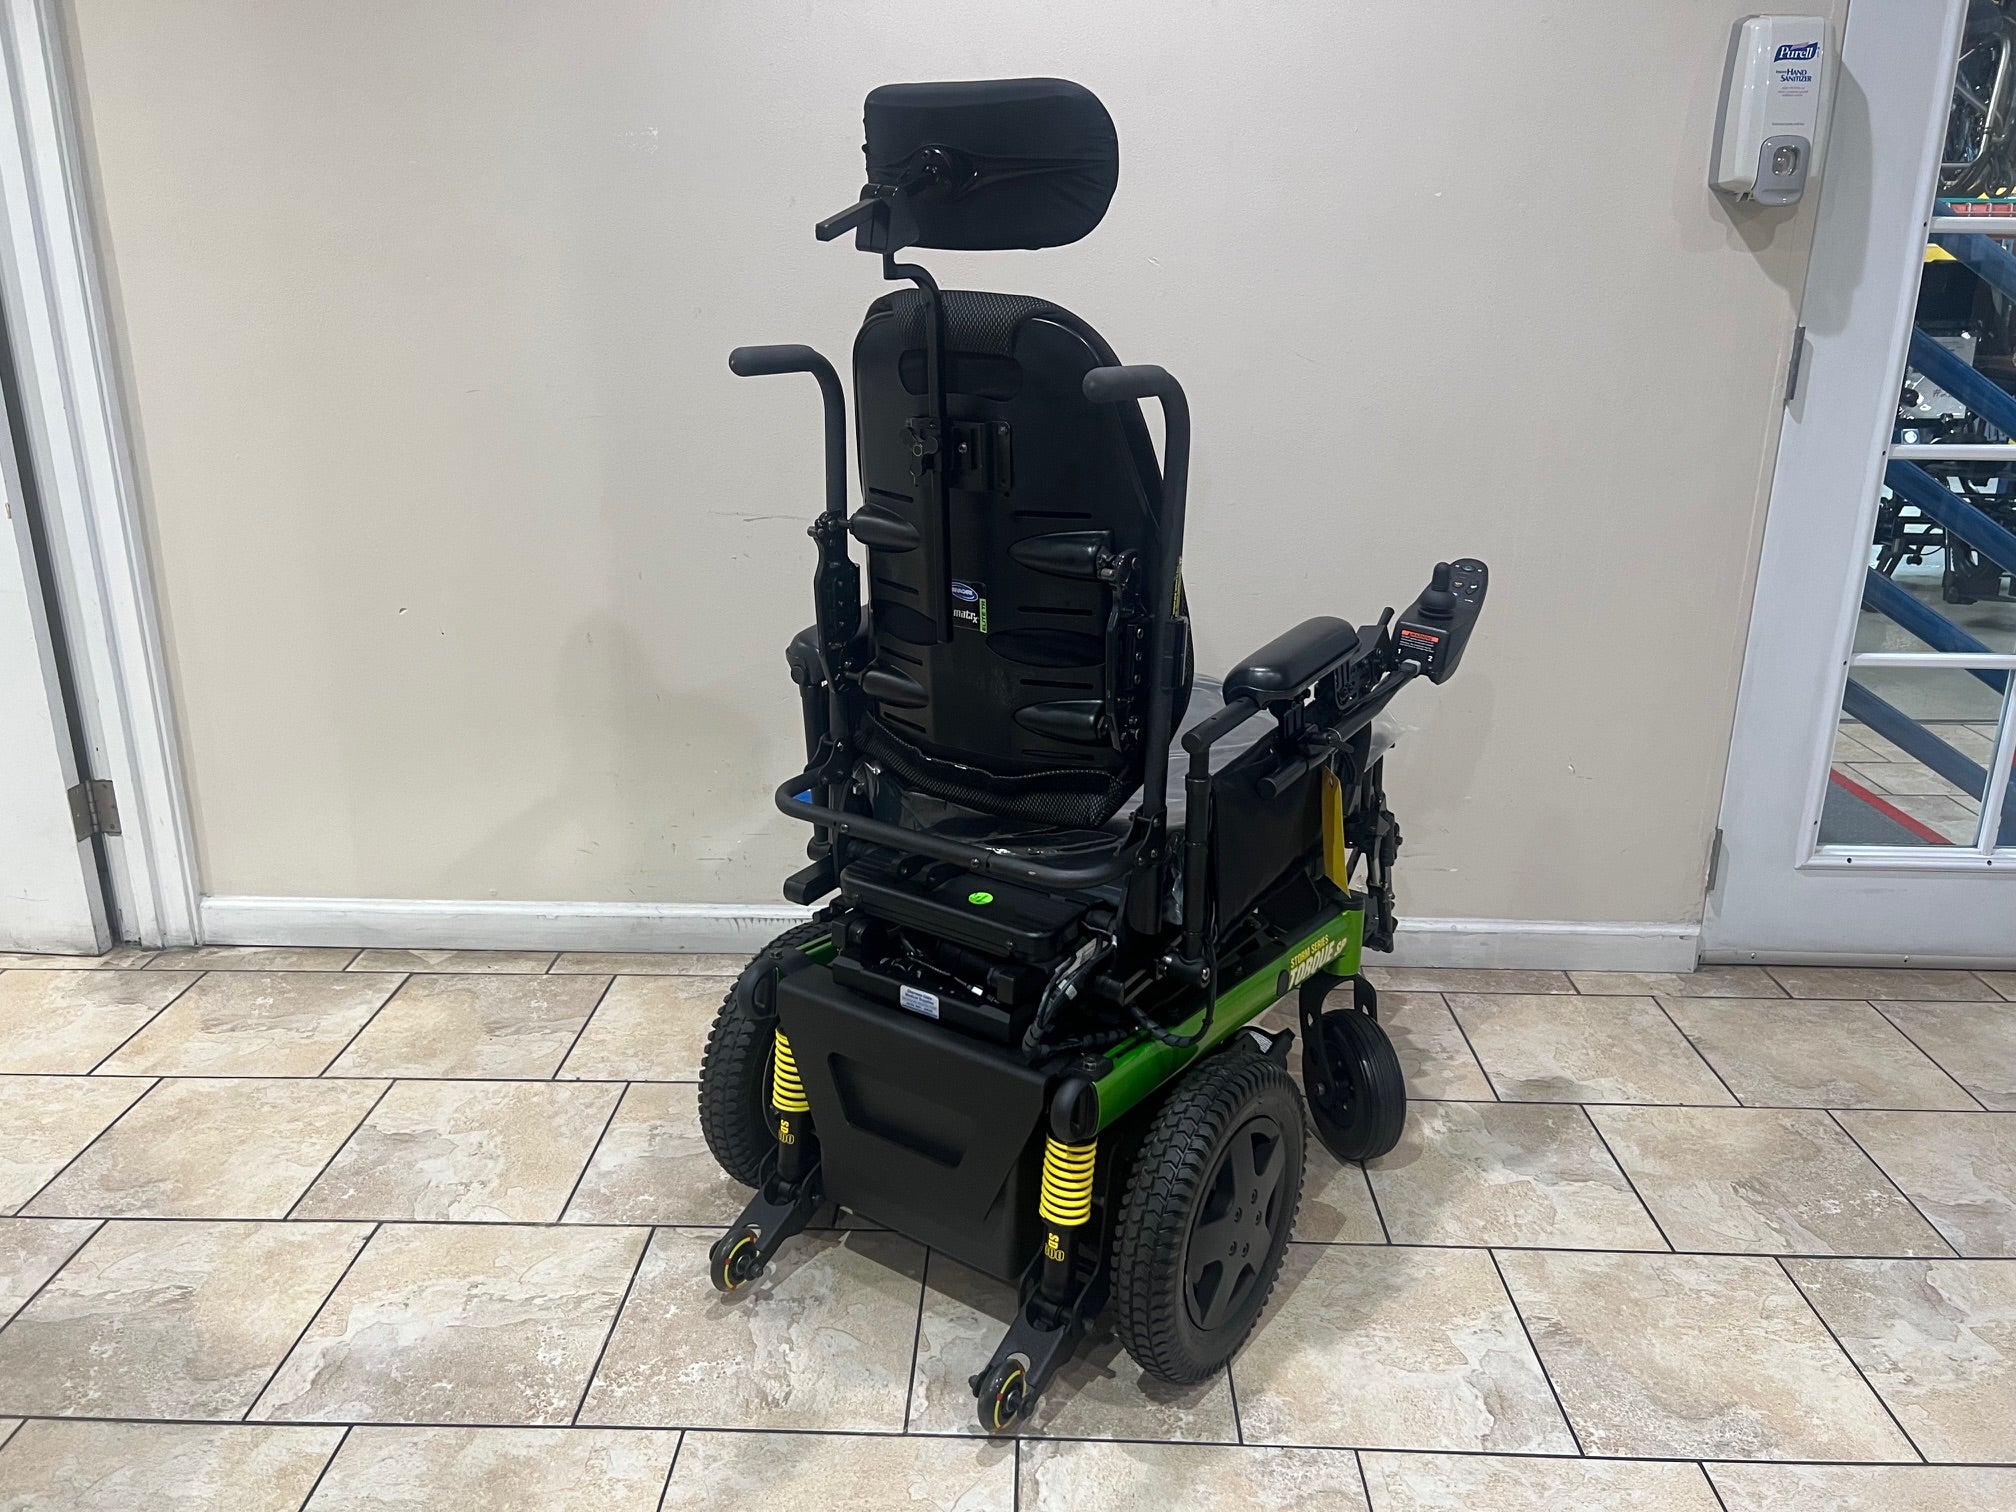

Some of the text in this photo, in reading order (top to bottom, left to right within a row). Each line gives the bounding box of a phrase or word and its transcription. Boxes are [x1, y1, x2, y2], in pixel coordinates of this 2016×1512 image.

[1779, 46, 1814, 59] Purell
[1786, 68, 1808, 76] HAND
[1290, 934, 1329, 969] STORM SERIES
[1288, 940, 1335, 991] TORQUE
